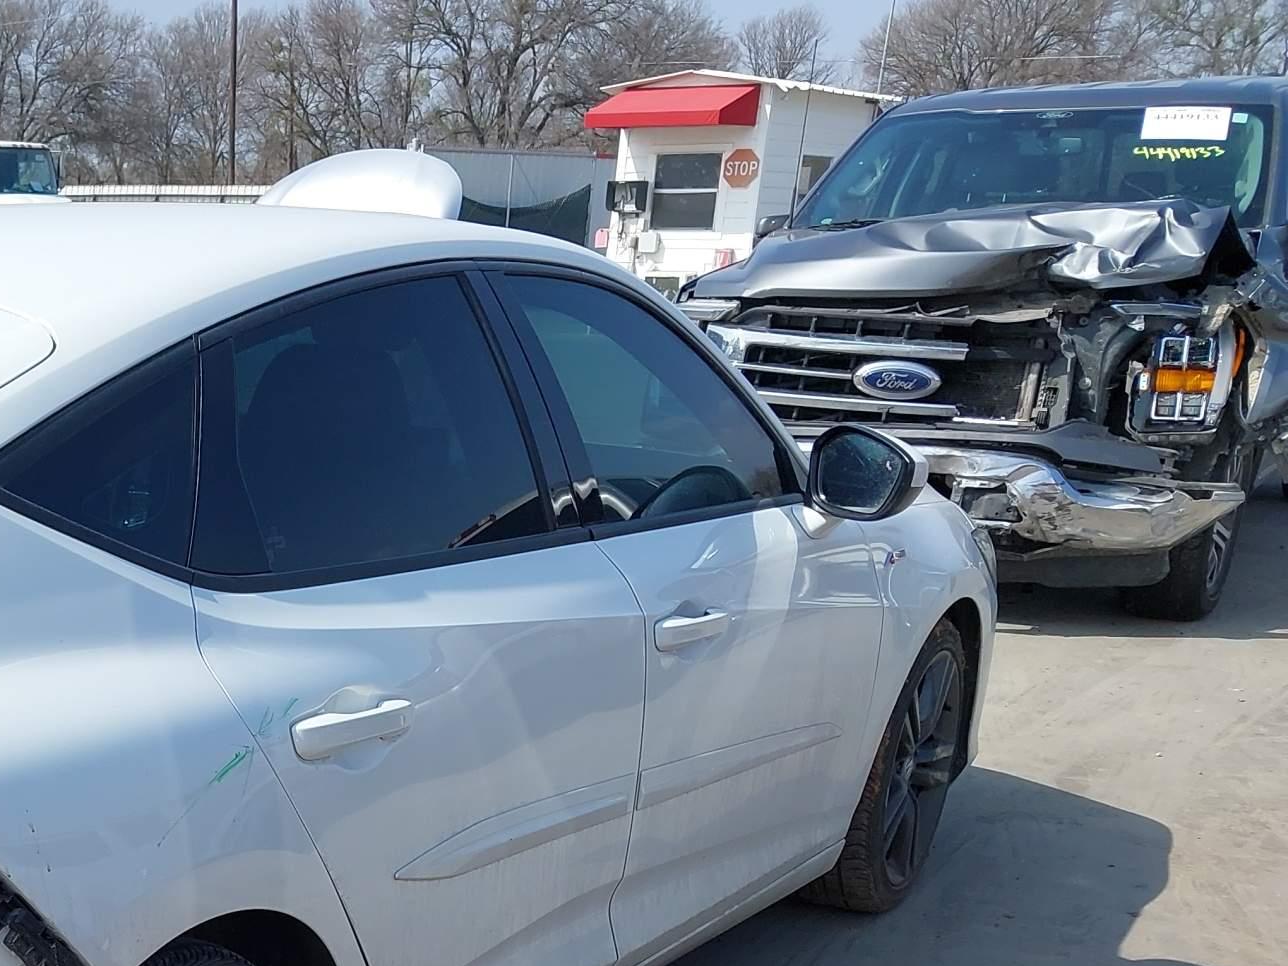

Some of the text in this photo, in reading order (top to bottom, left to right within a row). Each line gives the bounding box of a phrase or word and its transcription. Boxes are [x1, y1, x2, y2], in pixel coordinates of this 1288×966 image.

[1133, 146, 1226, 162] 44419133
[725, 160, 758, 177] STOP
[876, 371, 918, 391] Ford
